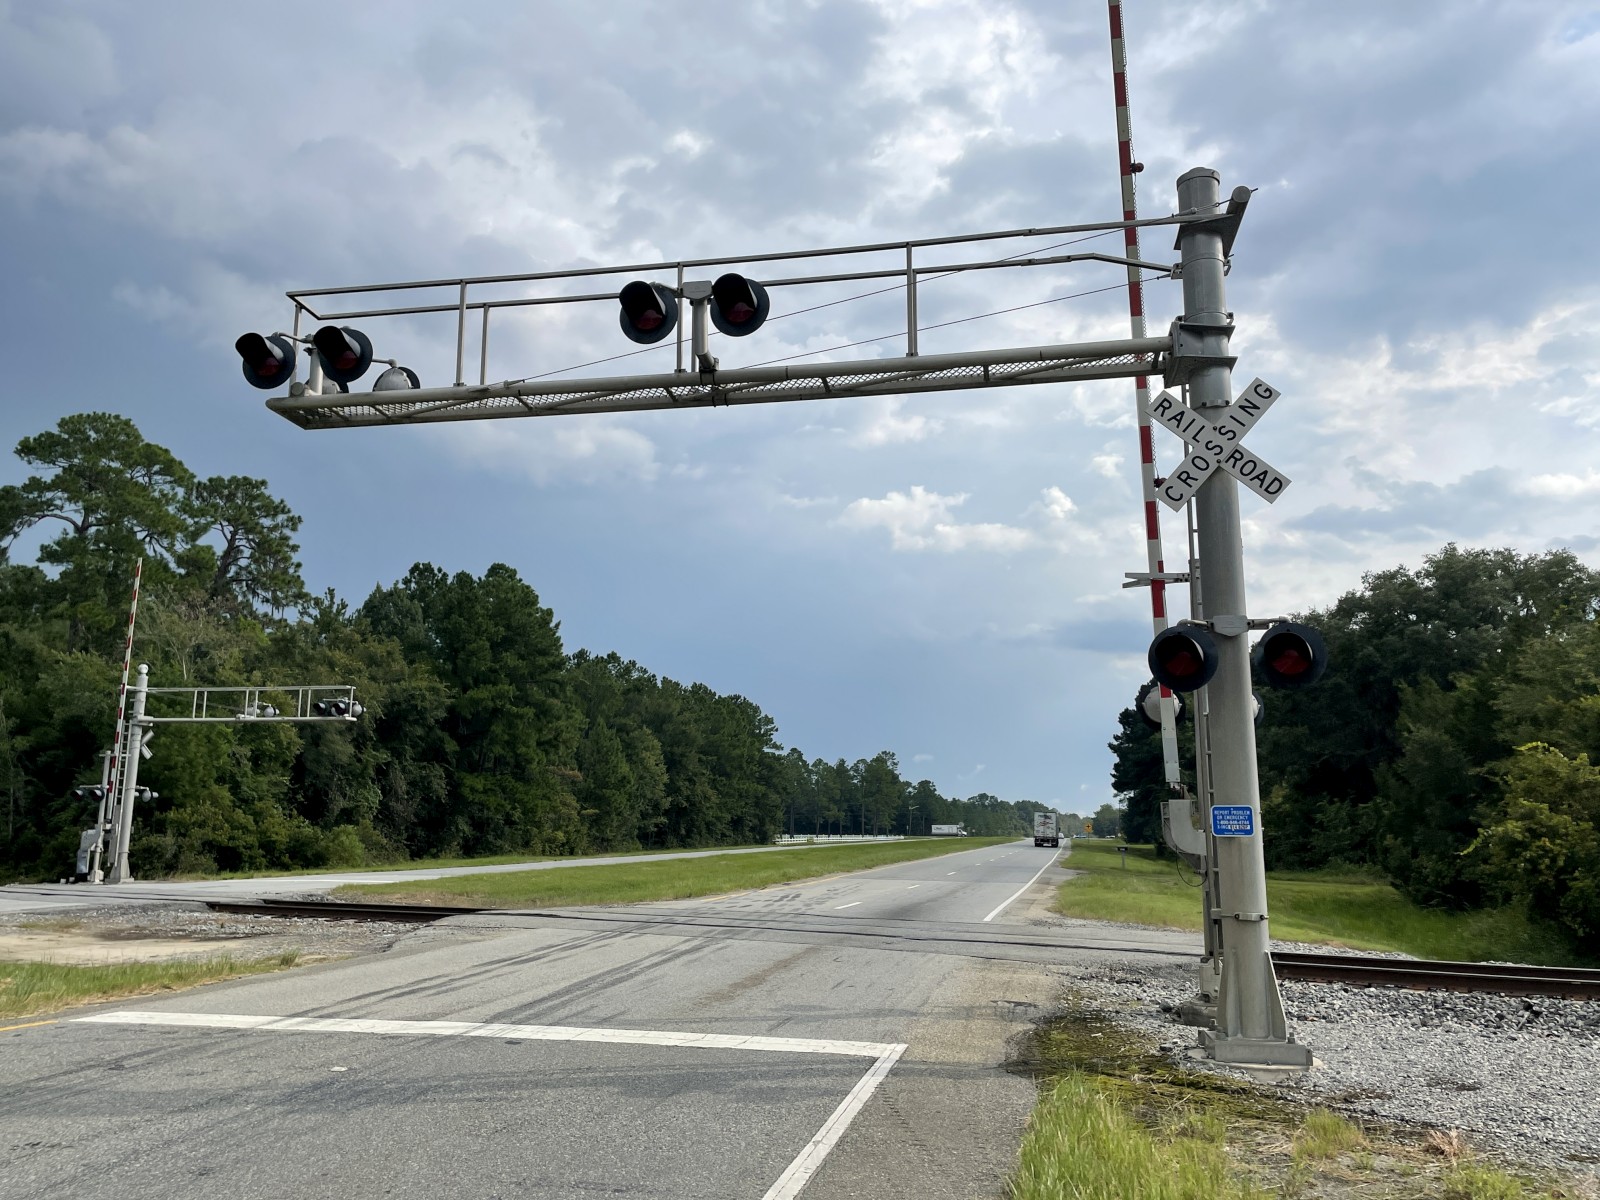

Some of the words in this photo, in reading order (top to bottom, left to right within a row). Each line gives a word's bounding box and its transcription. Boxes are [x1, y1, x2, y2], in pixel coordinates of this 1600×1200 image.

[1153, 397, 1206, 443] RAIL
[1164, 383, 1273, 502] CROSSING
[1224, 448, 1283, 495] ROAD
